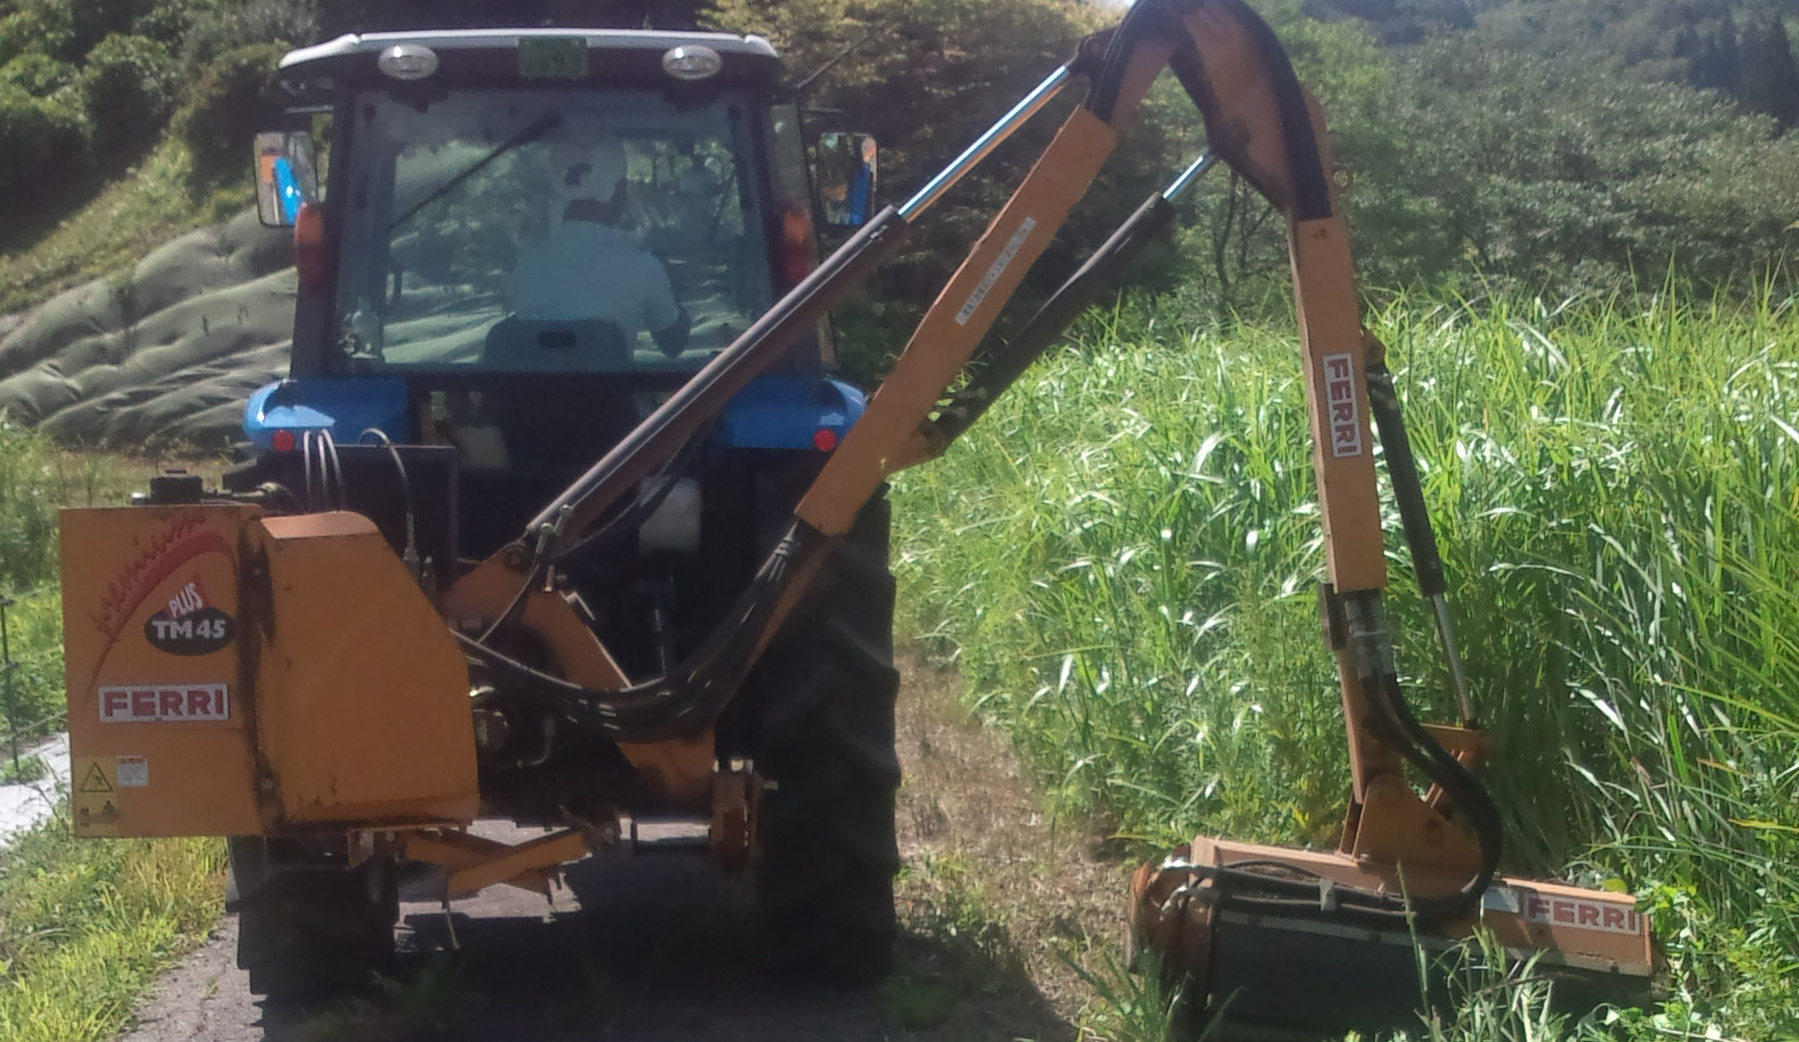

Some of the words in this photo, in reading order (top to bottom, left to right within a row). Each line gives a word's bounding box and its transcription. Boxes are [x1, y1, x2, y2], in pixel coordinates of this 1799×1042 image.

[1328, 358, 1357, 454] FERRI
[168, 582, 203, 618] PLUS
[104, 690, 224, 717] FERRI
[1527, 898, 1636, 931] FERRI
